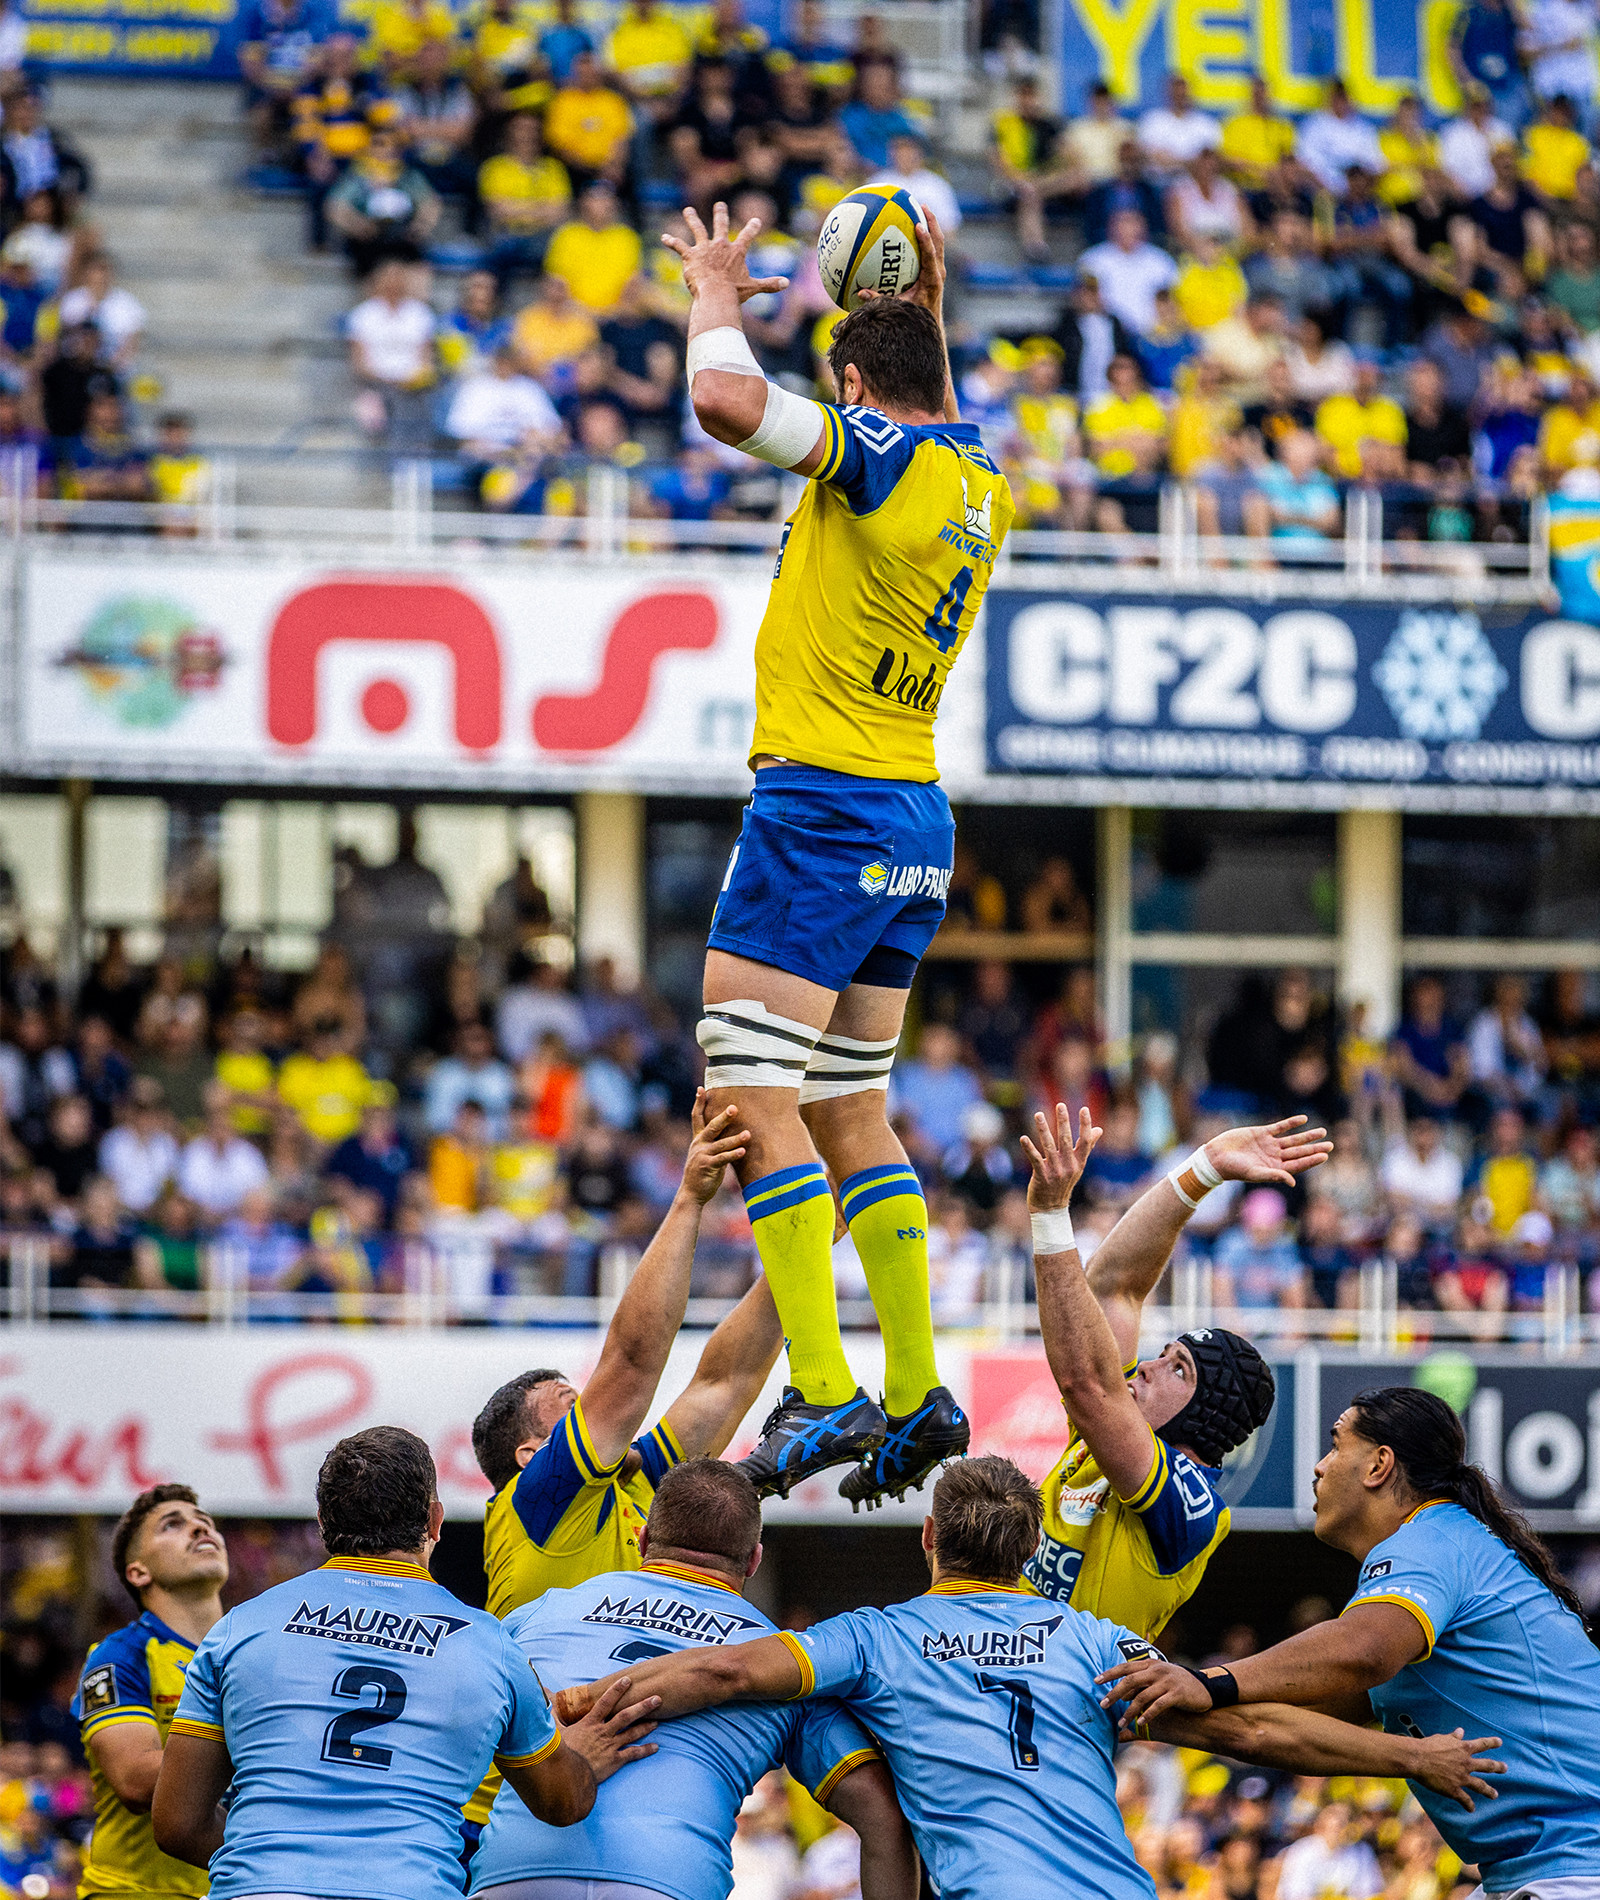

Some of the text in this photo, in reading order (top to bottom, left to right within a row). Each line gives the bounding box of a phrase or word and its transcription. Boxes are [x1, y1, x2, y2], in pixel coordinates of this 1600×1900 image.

[924, 565, 974, 654] 4
[1006, 600, 1359, 734] CF2C
[886, 865, 923, 896] LABO
[344, 1577, 369, 1587] SEMPRE
[290, 1600, 445, 1650] MAURIN
[290, 1625, 407, 1651] AUTOMOBILES
[588, 1614, 698, 1640] AUTOMOBILES
[592, 1594, 738, 1638] MAURIN
[922, 1628, 1046, 1657] MAURIN
[320, 1665, 407, 1771] 2
[973, 1672, 1040, 1772] 7
